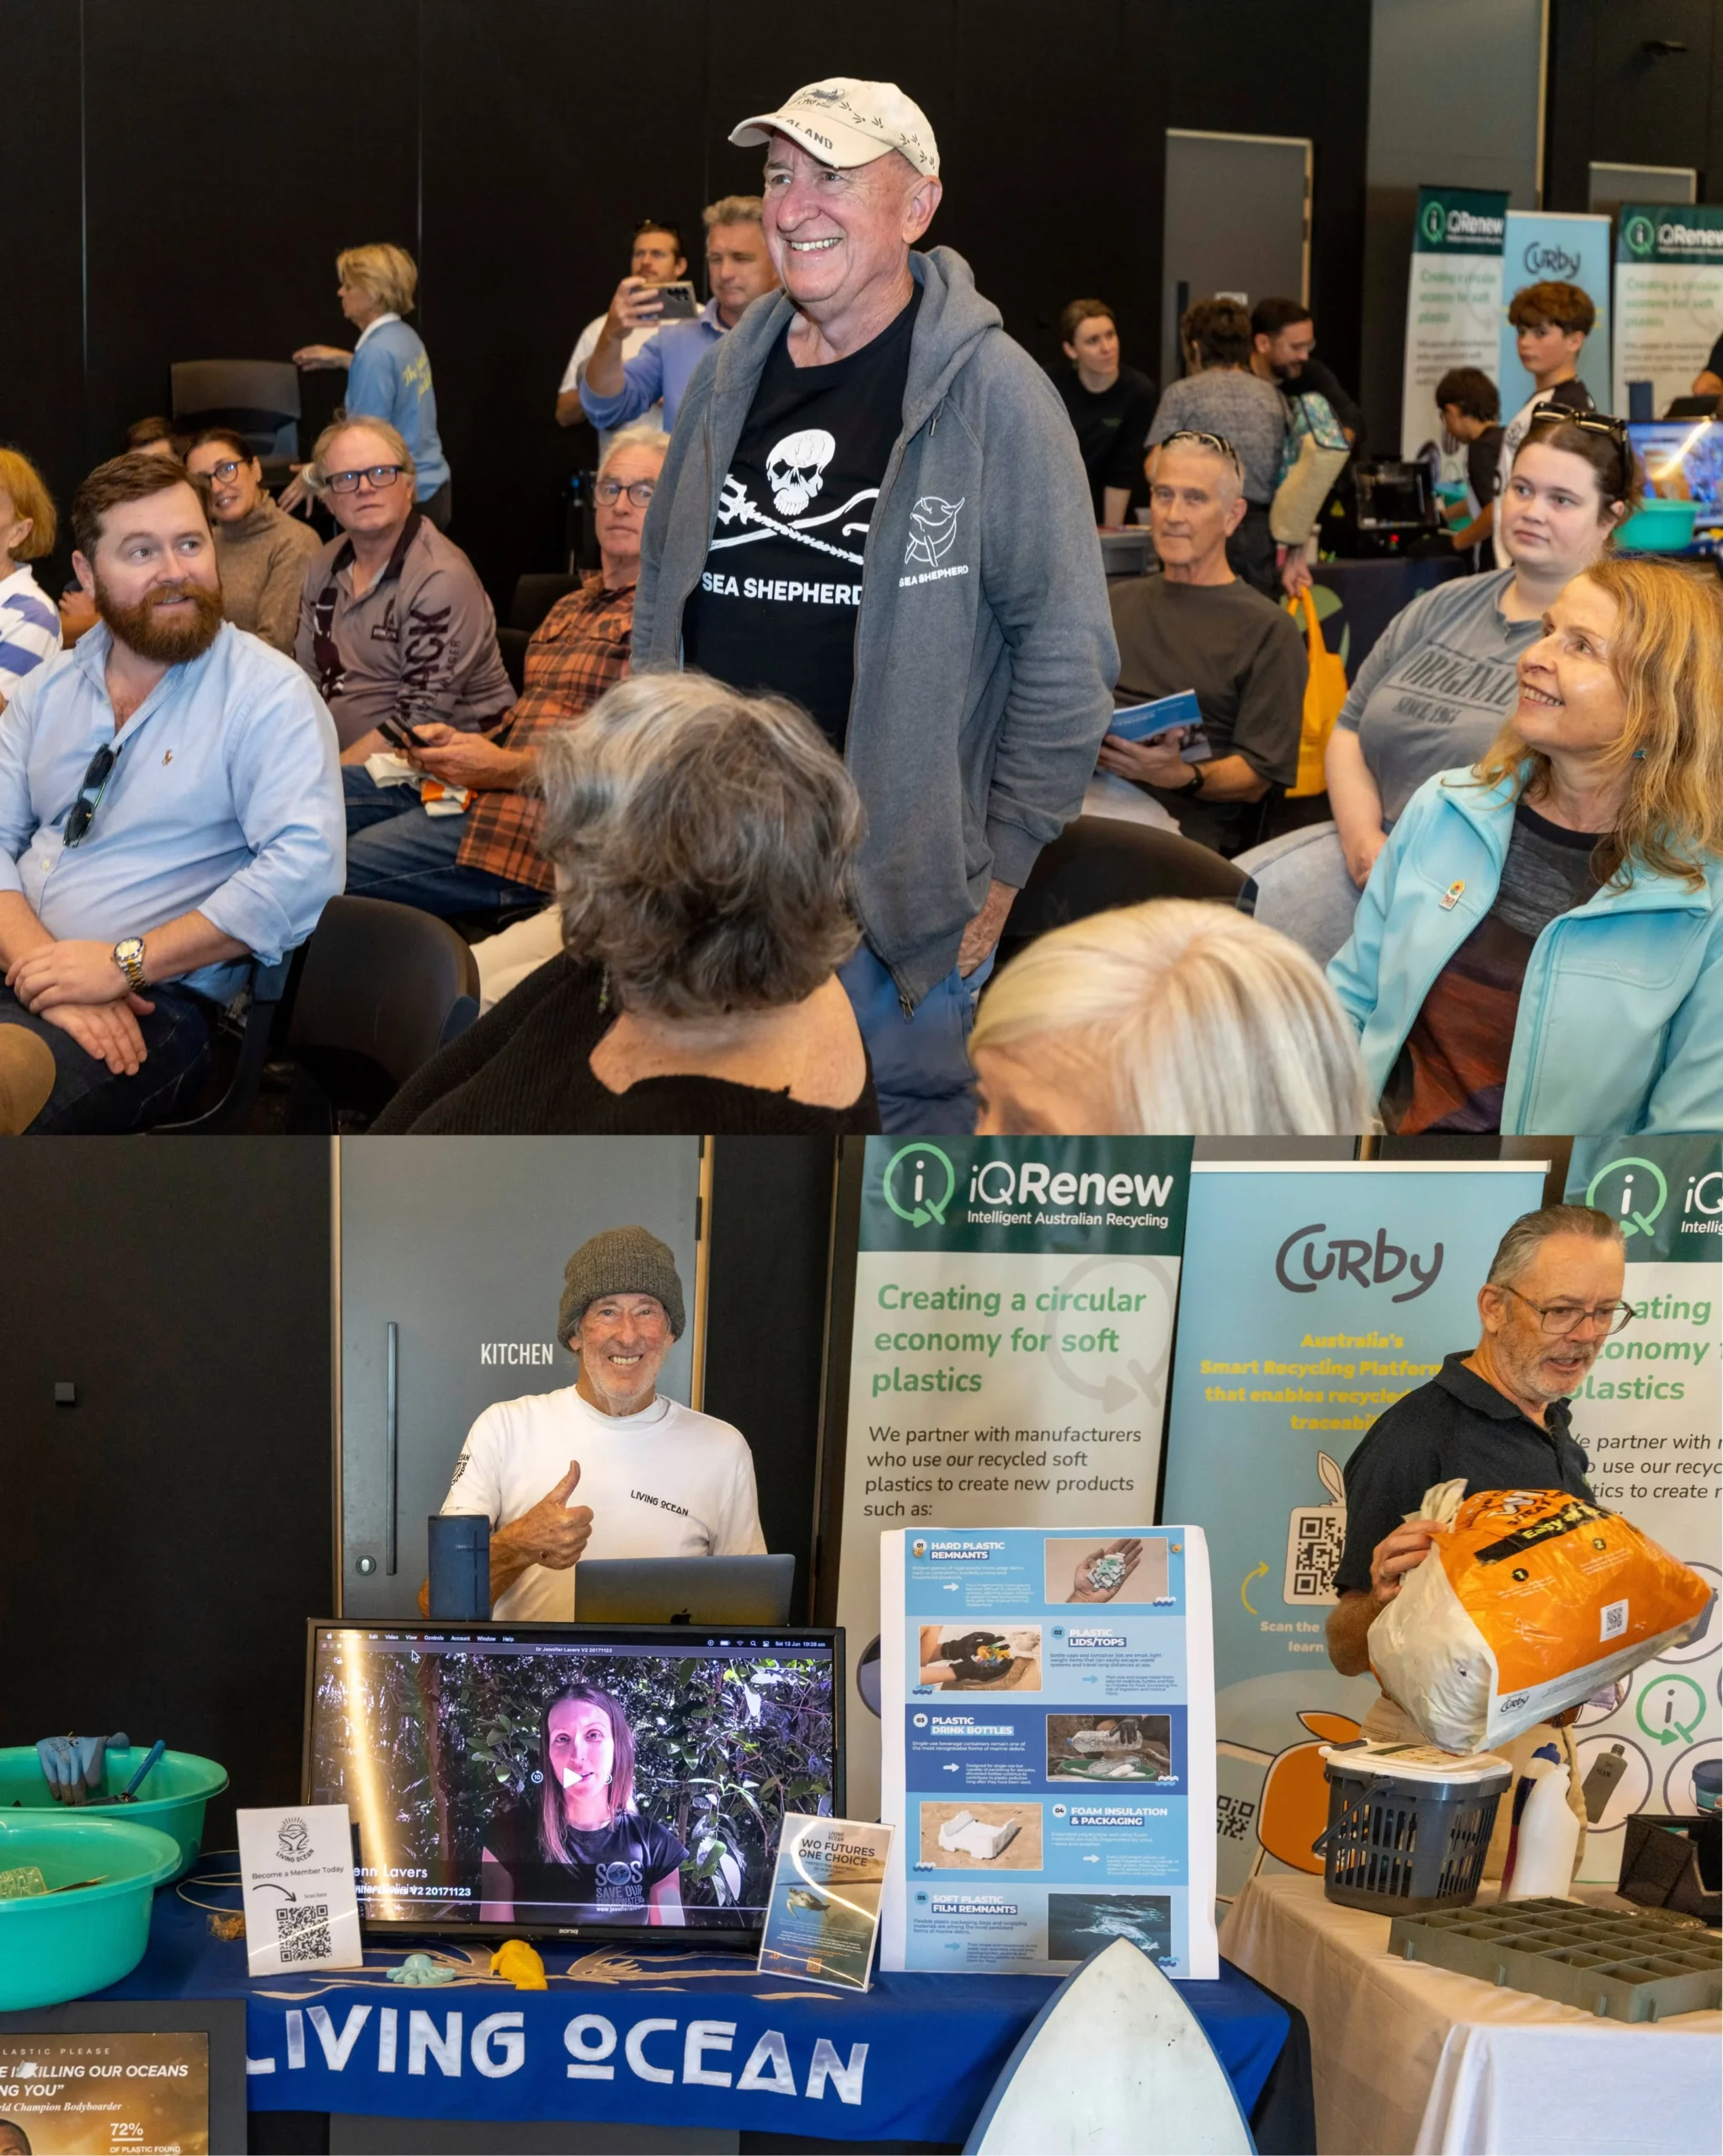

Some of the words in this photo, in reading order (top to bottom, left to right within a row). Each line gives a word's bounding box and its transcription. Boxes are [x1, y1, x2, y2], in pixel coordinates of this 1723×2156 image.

[899, 574, 918, 587] SEA
[918, 565, 968, 583] SHEPHERD
[702, 572, 739, 597] SEA
[969, 1161, 1173, 1208] iQRenew
[968, 1210, 1032, 1226] Intelligent
[1035, 1211, 1102, 1226] Australian
[1106, 1213, 1169, 1229] Recycling
[878, 1284, 1001, 1316] Creating
[1011, 1292, 1026, 1311] a
[1035, 1286, 1147, 1312] circular
[874, 1331, 1002, 1358] economy
[1011, 1327, 1052, 1353] for
[1061, 1327, 1119, 1353] soft
[1300, 1331, 1404, 1348] Australia's
[481, 1343, 553, 1364] KITCHEN
[1200, 1359, 1259, 1374] Smart
[1263, 1358, 1355, 1379] Recycling
[872, 1367, 983, 1397] plastics
[1205, 1387, 1246, 1401] that
[1251, 1388, 1324, 1402] enables
[869, 1426, 900, 1442] We
[906, 1427, 969, 1445] partner
[974, 1426, 1010, 1442] with
[1015, 1426, 1141, 1442] manufacturers
[1597, 1434, 1667, 1452] partner
[1673, 1433, 1710, 1449] with
[867, 1451, 906, 1467] who
[912, 1454, 942, 1467] use
[946, 1454, 974, 1466] our
[978, 1451, 1046, 1470] recycled
[1053, 1451, 1088, 1466] soft
[1603, 1462, 1634, 1473] use
[1640, 1462, 1671, 1473] our
[866, 1476, 932, 1494] plastics
[937, 1478, 953, 1491] to
[958, 1477, 1009, 1491] create
[1014, 1479, 1050, 1491] new
[1057, 1476, 1134, 1493] products
[1630, 1484, 1647, 1497] to
[1653, 1484, 1708, 1498] create
[631, 1490, 659, 1506] LIVING
[660, 1500, 689, 1517] OCEAN
[863, 1501, 905, 1516] such
[910, 1503, 933, 1516] as:
[1261, 1621, 1293, 1632] Scan
[1296, 1620, 1320, 1632] the
[1070, 1638, 1124, 1646] LIDS/TOPS
[1288, 1641, 1324, 1652] learn
[967, 1726, 1012, 1735] BOTTLES
[1071, 1807, 1102, 1816] FOAM
[1105, 1807, 1168, 1816] INSULATION
[1071, 1817, 1079, 1825] &
[1081, 1817, 1144, 1825] PACKAGING
[802, 1838, 822, 1849] WO
[824, 1843, 875, 1857] FUTURES
[276, 1850, 295, 1863] LIVING
[798, 1849, 822, 1860] ONE
[825, 1853, 867, 1866] CHOICE
[253, 1870, 282, 1879] Become
[291, 1867, 320, 1876] Member
[323, 1865, 344, 1874] Today
[354, 1867, 377, 1877] enn
[383, 1865, 428, 1878] Lavers
[425, 1886, 472, 1897] 20171123
[596, 1886, 622, 1898] SAVE
[625, 1885, 643, 1897] OUR
[961, 1895, 1004, 1903] PLASTIC
[933, 1904, 957, 1913] FILM
[958, 1905, 1016, 1913] REMNANTS
[563, 2013, 870, 2105] OCEAN
[89, 2066, 122, 2078] OUR
[126, 2065, 189, 2078] OCEANS
[13, 2102, 61, 2114] Champion
[63, 2102, 122, 2113] Bodyboarder
[110, 2122, 144, 2137] 72%
